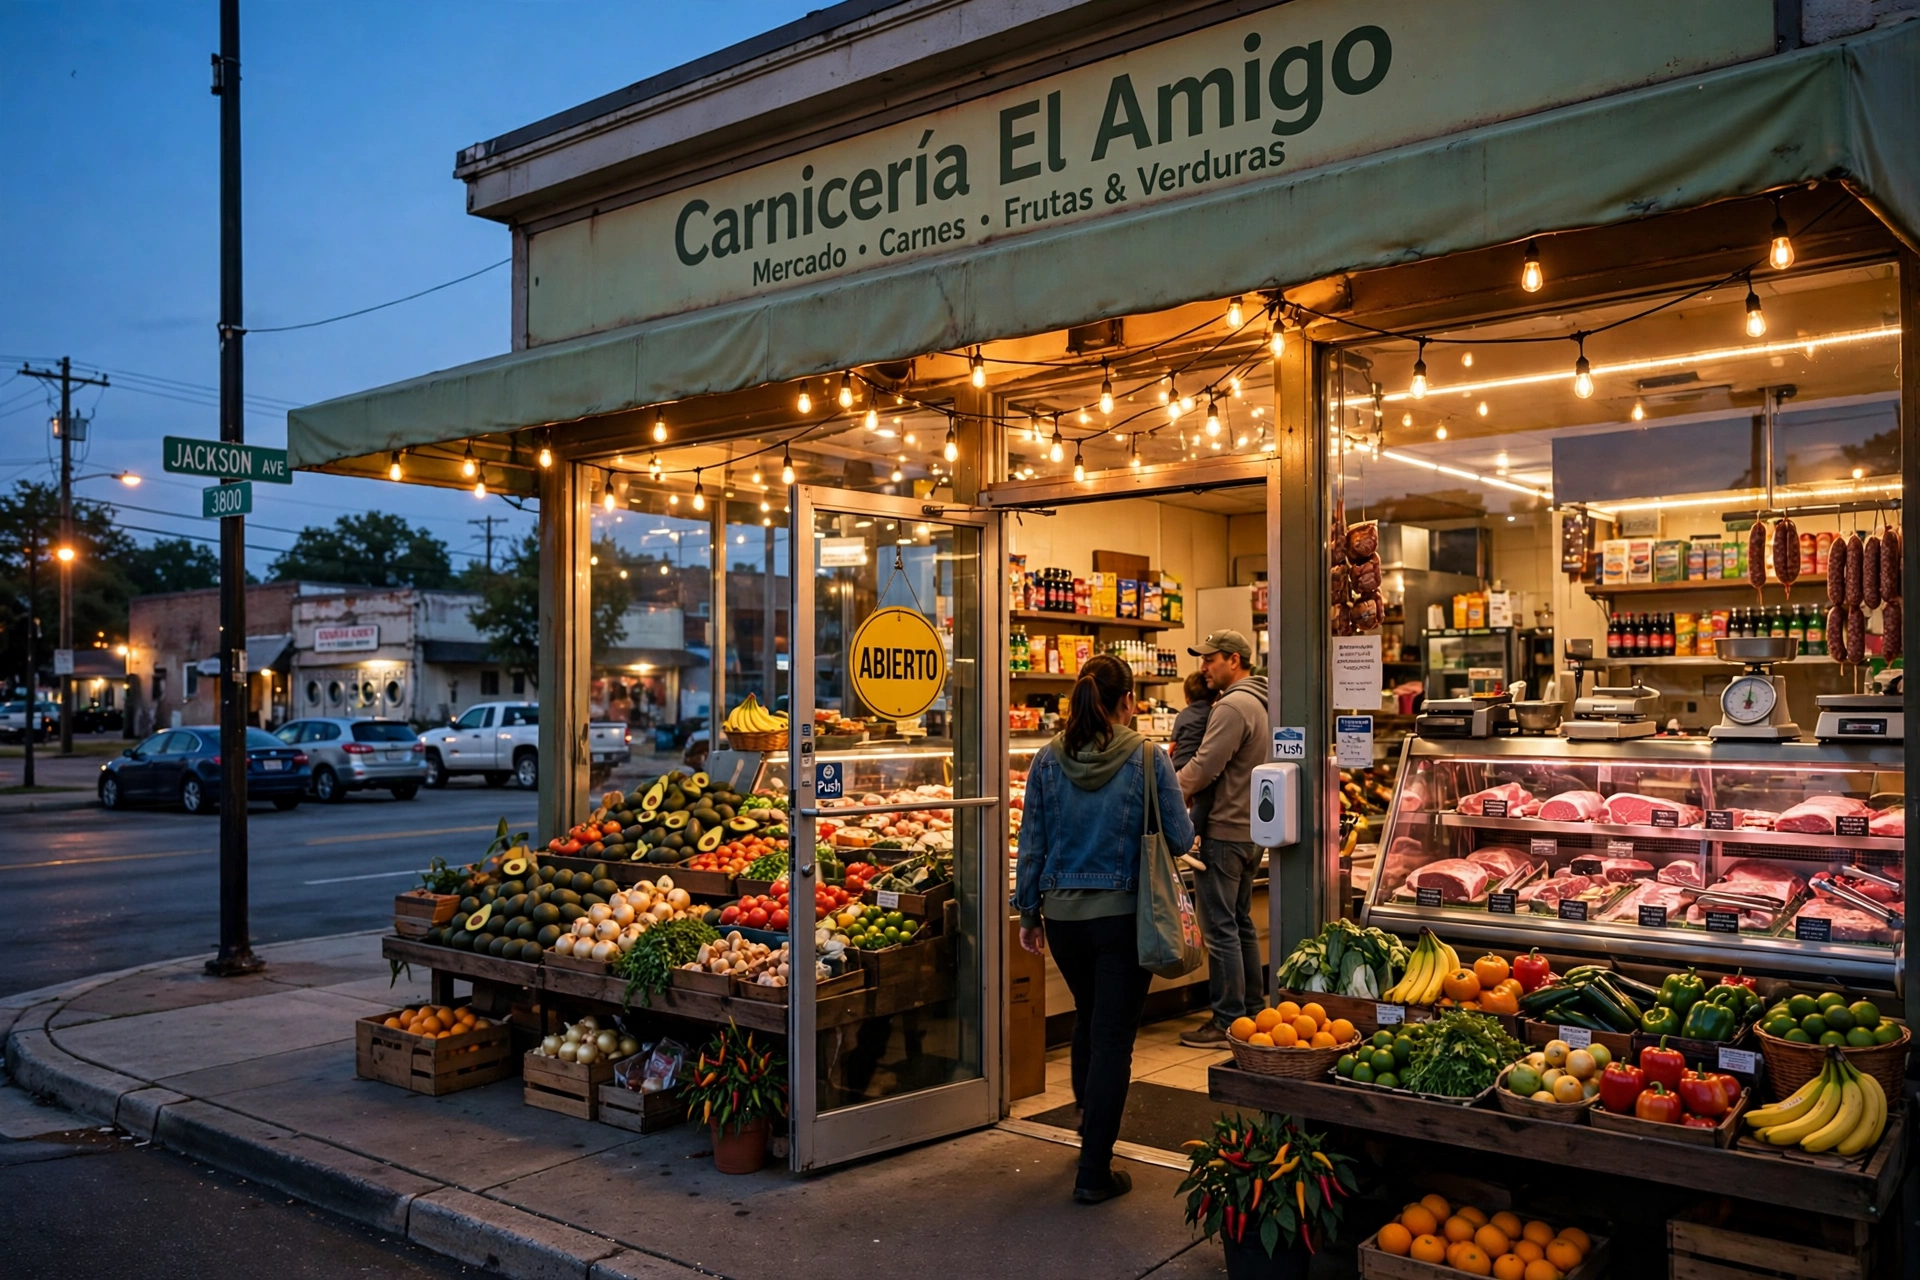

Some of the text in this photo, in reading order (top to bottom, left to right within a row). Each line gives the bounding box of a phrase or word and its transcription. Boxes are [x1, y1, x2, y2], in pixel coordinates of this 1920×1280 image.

[675, 25, 1393, 267] Carnicería El Amigo
[753, 242, 847, 287] Mercado
[879, 218, 966, 257] Carnes
[1005, 187, 1093, 228] Frutas
[1104, 173, 1128, 204] &
[1137, 140, 1286, 196] Verduras
[171, 443, 285, 477] JACKSON AVE
[211, 488, 242, 514] 3800
[858, 646, 938, 681] ABIERTO
[817, 778, 841, 794] Push
